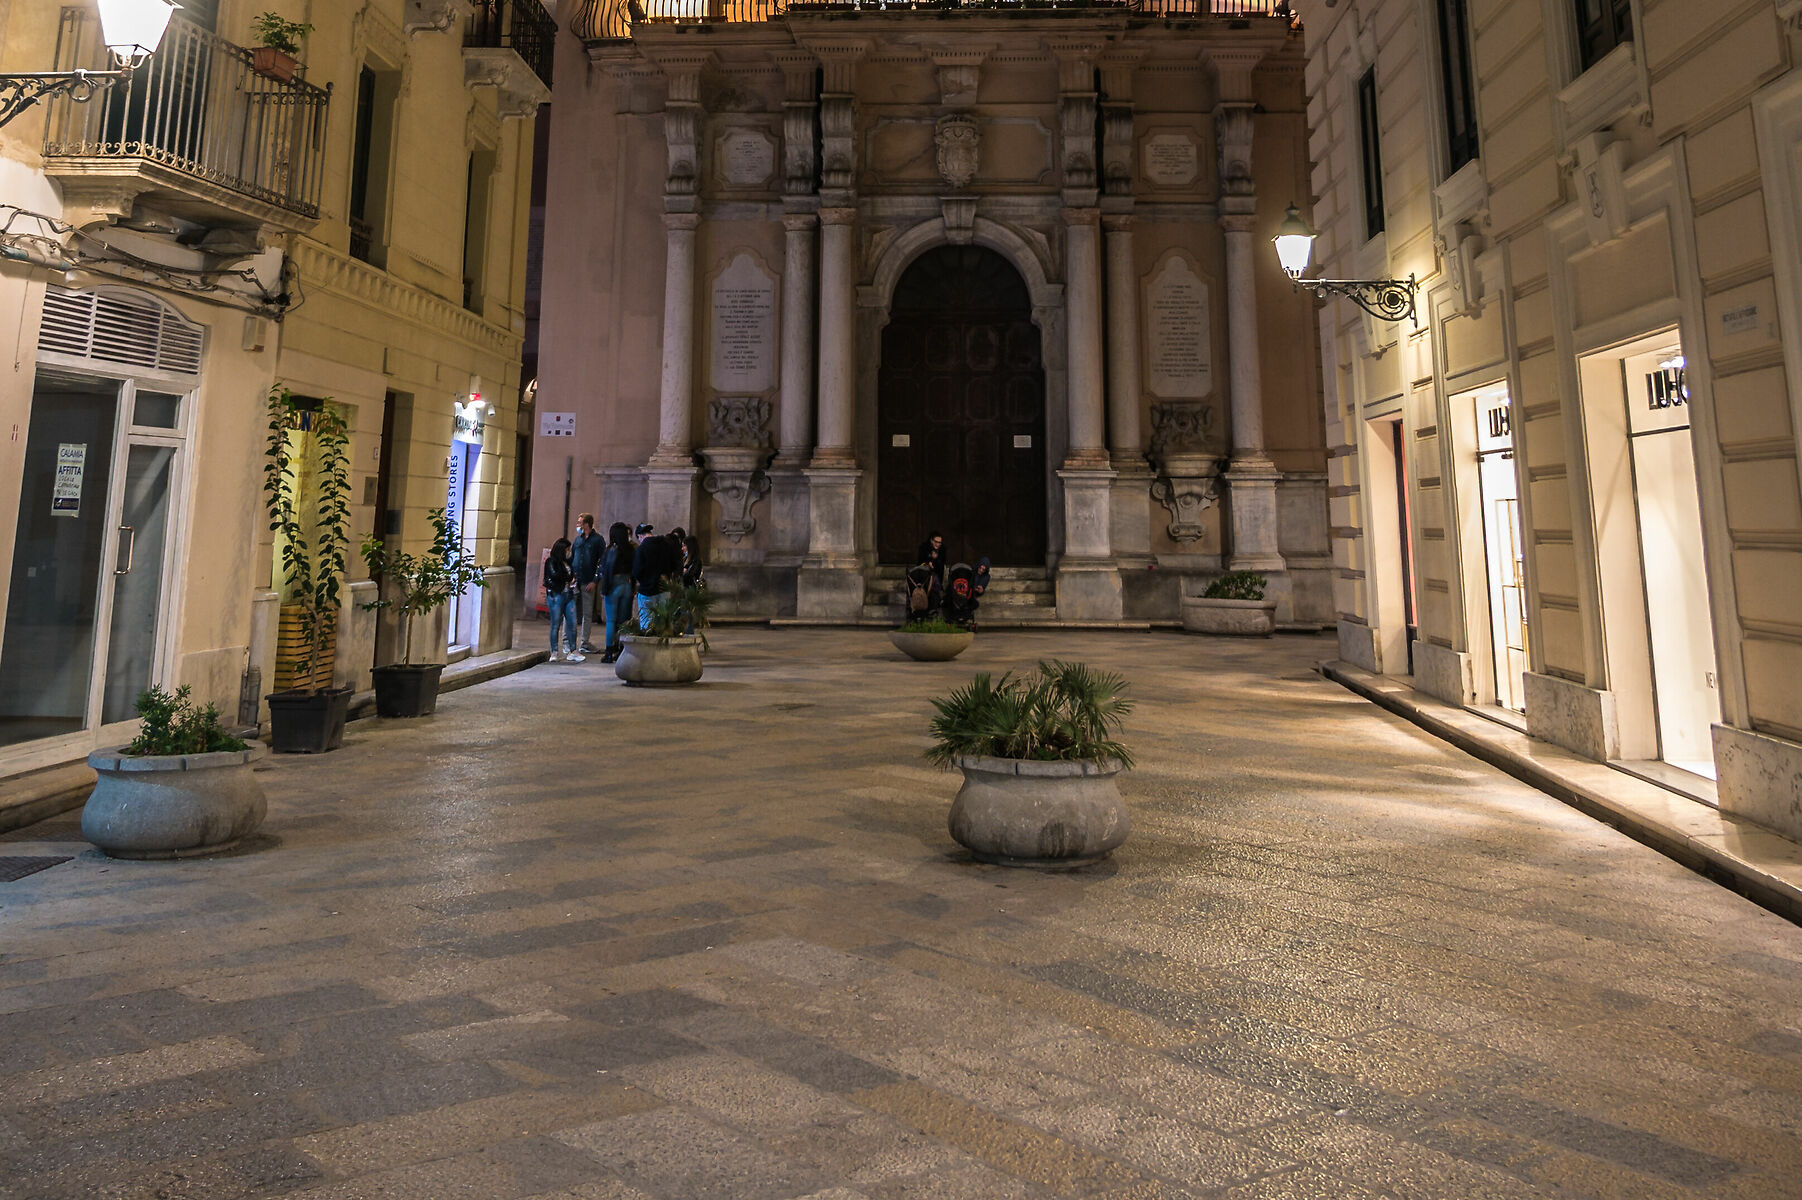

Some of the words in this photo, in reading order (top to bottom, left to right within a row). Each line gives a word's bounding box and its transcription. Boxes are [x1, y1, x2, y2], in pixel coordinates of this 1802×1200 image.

[60, 447, 83, 458] CALAMIA
[58, 465, 82, 475] AFFITTA
[447, 455, 458, 497] STORES
